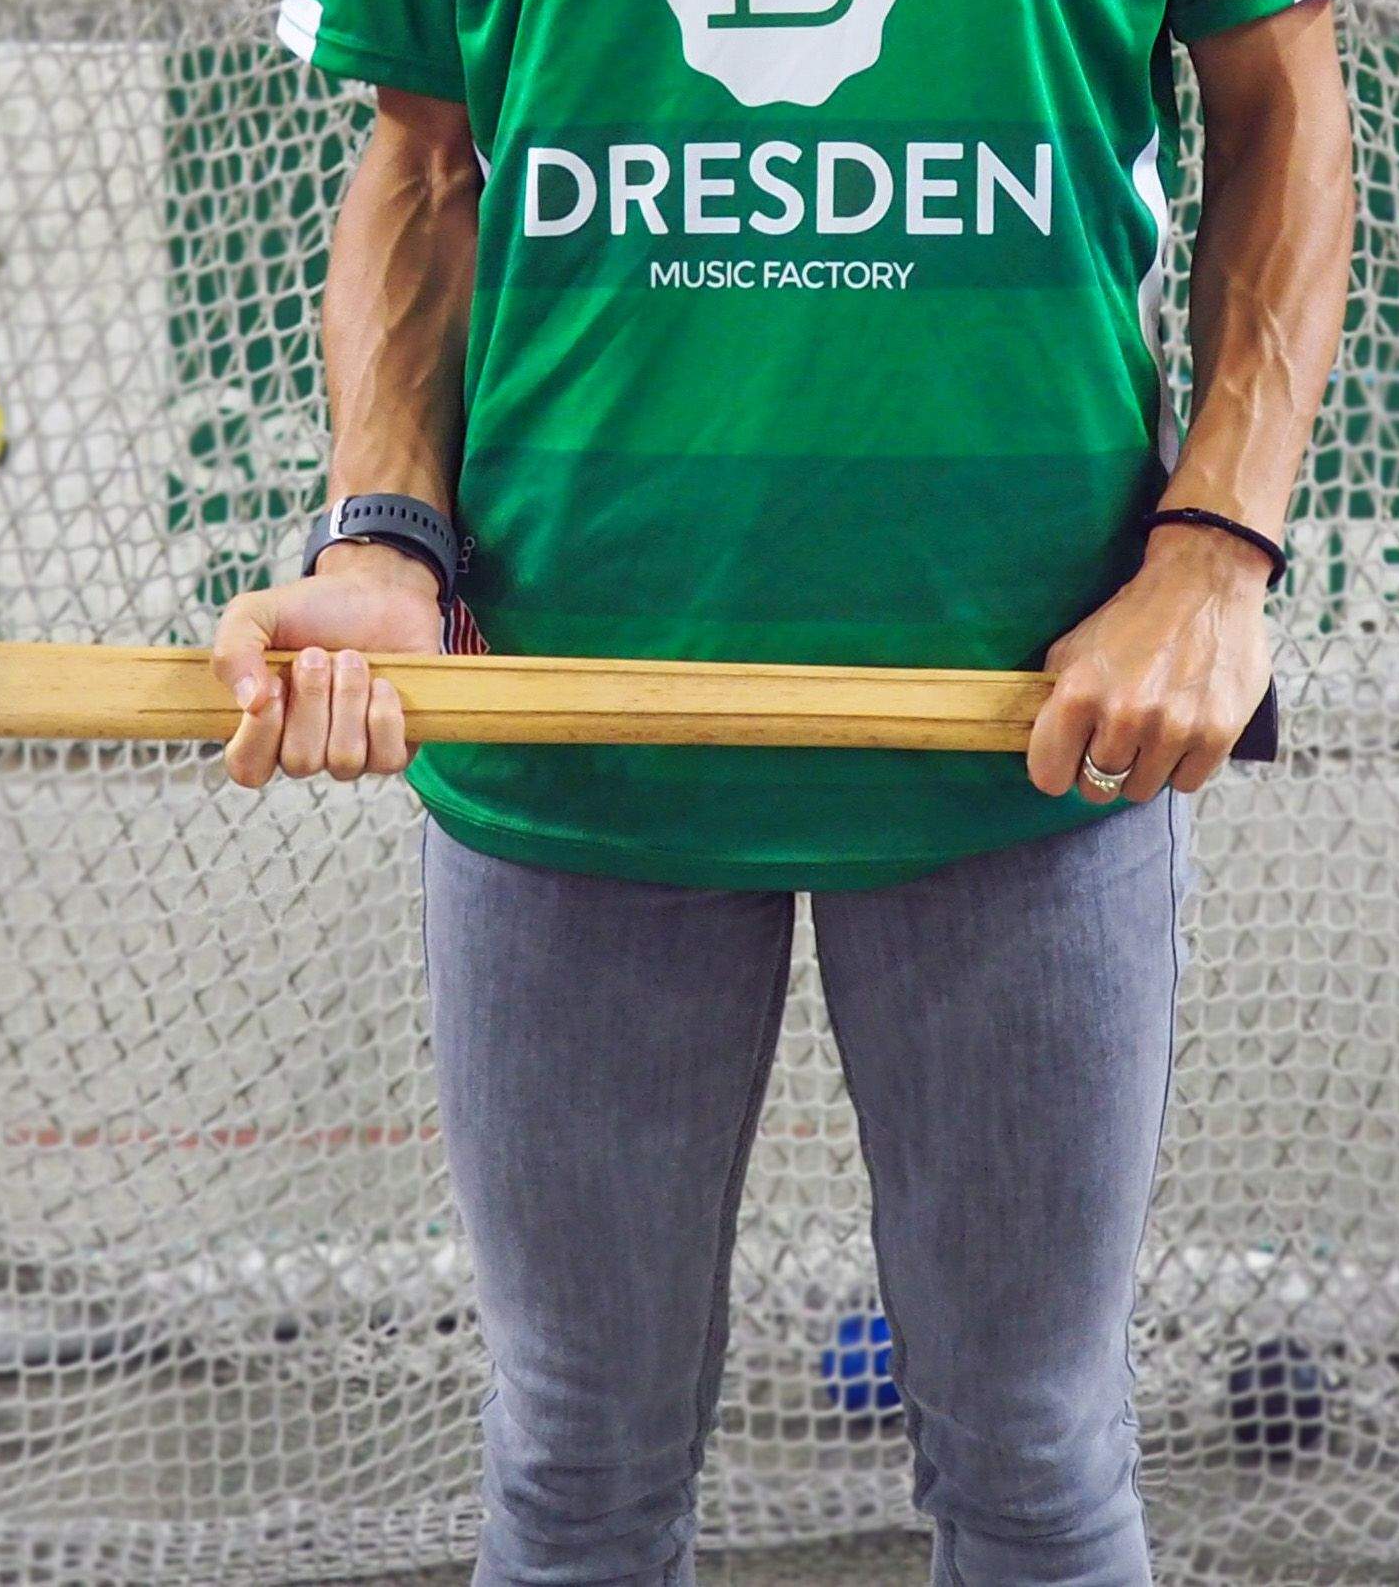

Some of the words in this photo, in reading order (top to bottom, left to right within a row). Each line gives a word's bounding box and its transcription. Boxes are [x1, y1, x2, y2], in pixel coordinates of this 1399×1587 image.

[524, 140, 1053, 237] DRESDEN
[650, 260, 756, 289] MUSIC
[763, 260, 915, 290] FACTORY
